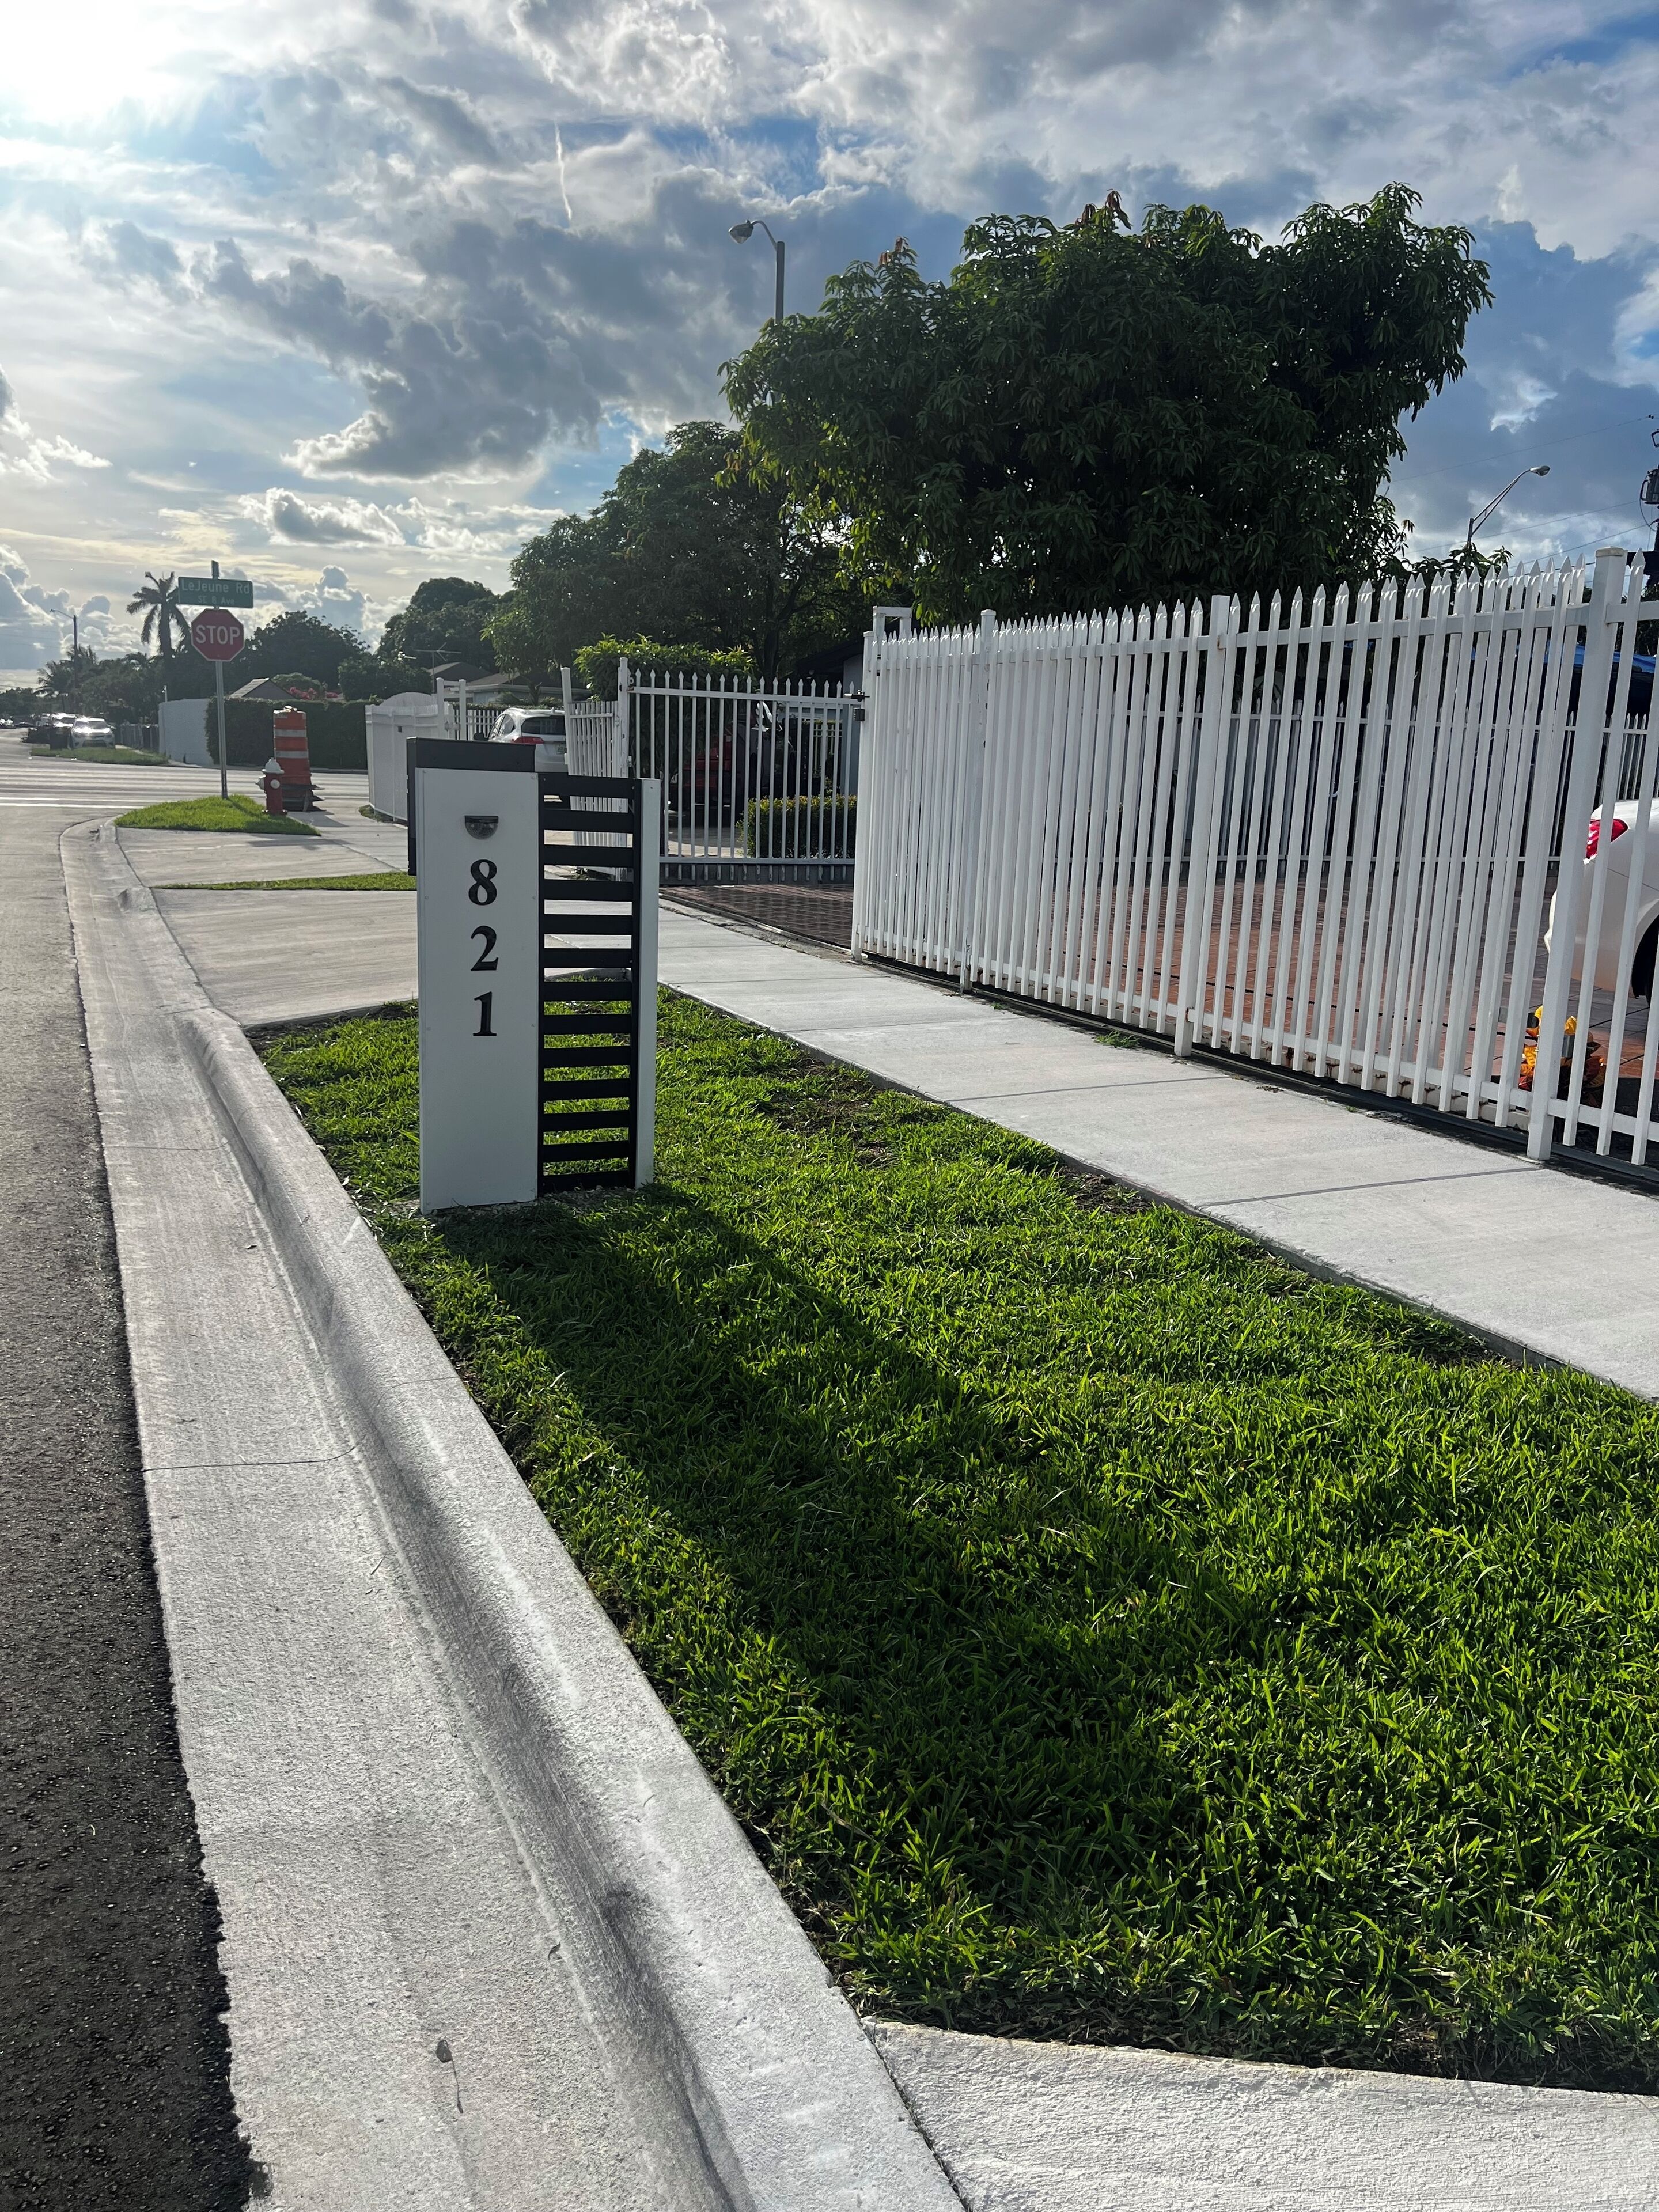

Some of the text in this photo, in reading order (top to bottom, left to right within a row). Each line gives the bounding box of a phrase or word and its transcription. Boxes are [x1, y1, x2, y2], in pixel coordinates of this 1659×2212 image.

[181, 579, 249, 594] LeJeune Rd
[198, 595, 207, 604] SE
[221, 597, 235, 605] Ave
[196, 624, 240, 645] STOP
